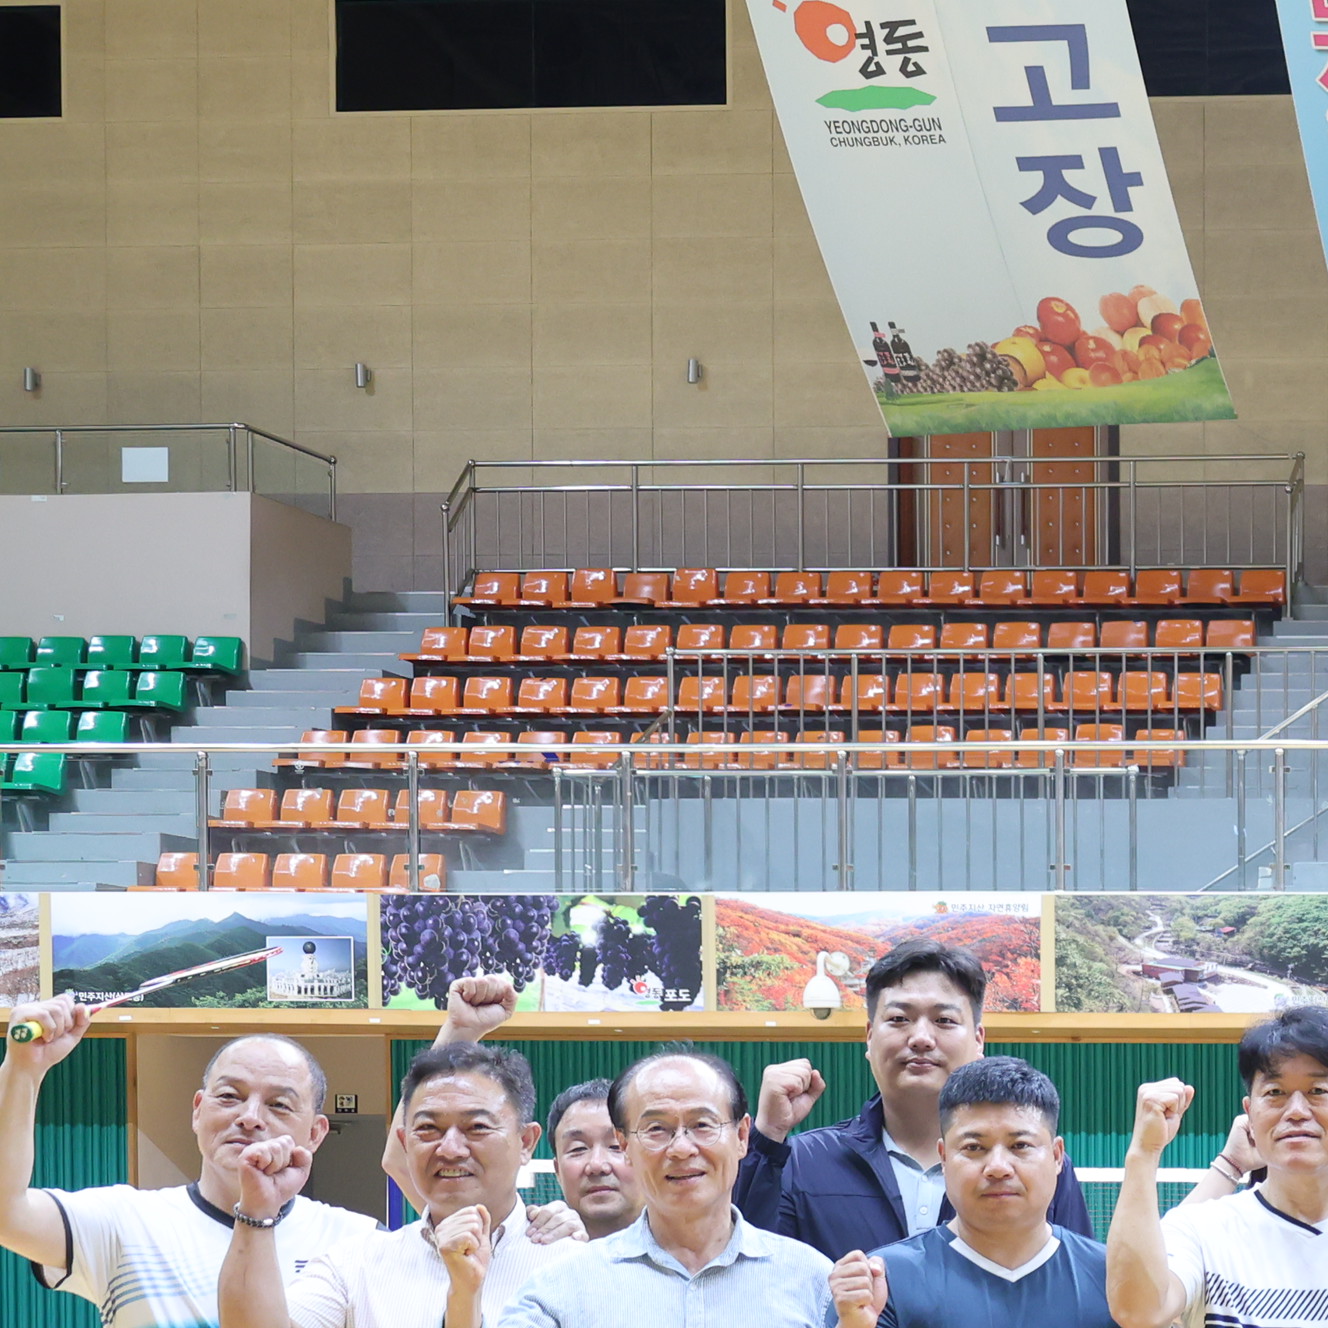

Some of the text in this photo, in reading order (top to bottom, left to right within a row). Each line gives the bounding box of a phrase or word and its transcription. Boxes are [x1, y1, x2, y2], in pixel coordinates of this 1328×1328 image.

[824, 117, 942, 135] YEONGDONG-GUN
[829, 134, 947, 149] CHUNGBUK, KOREA
[986, 24, 1144, 258] 고장
[664, 987, 692, 1002] 포도
